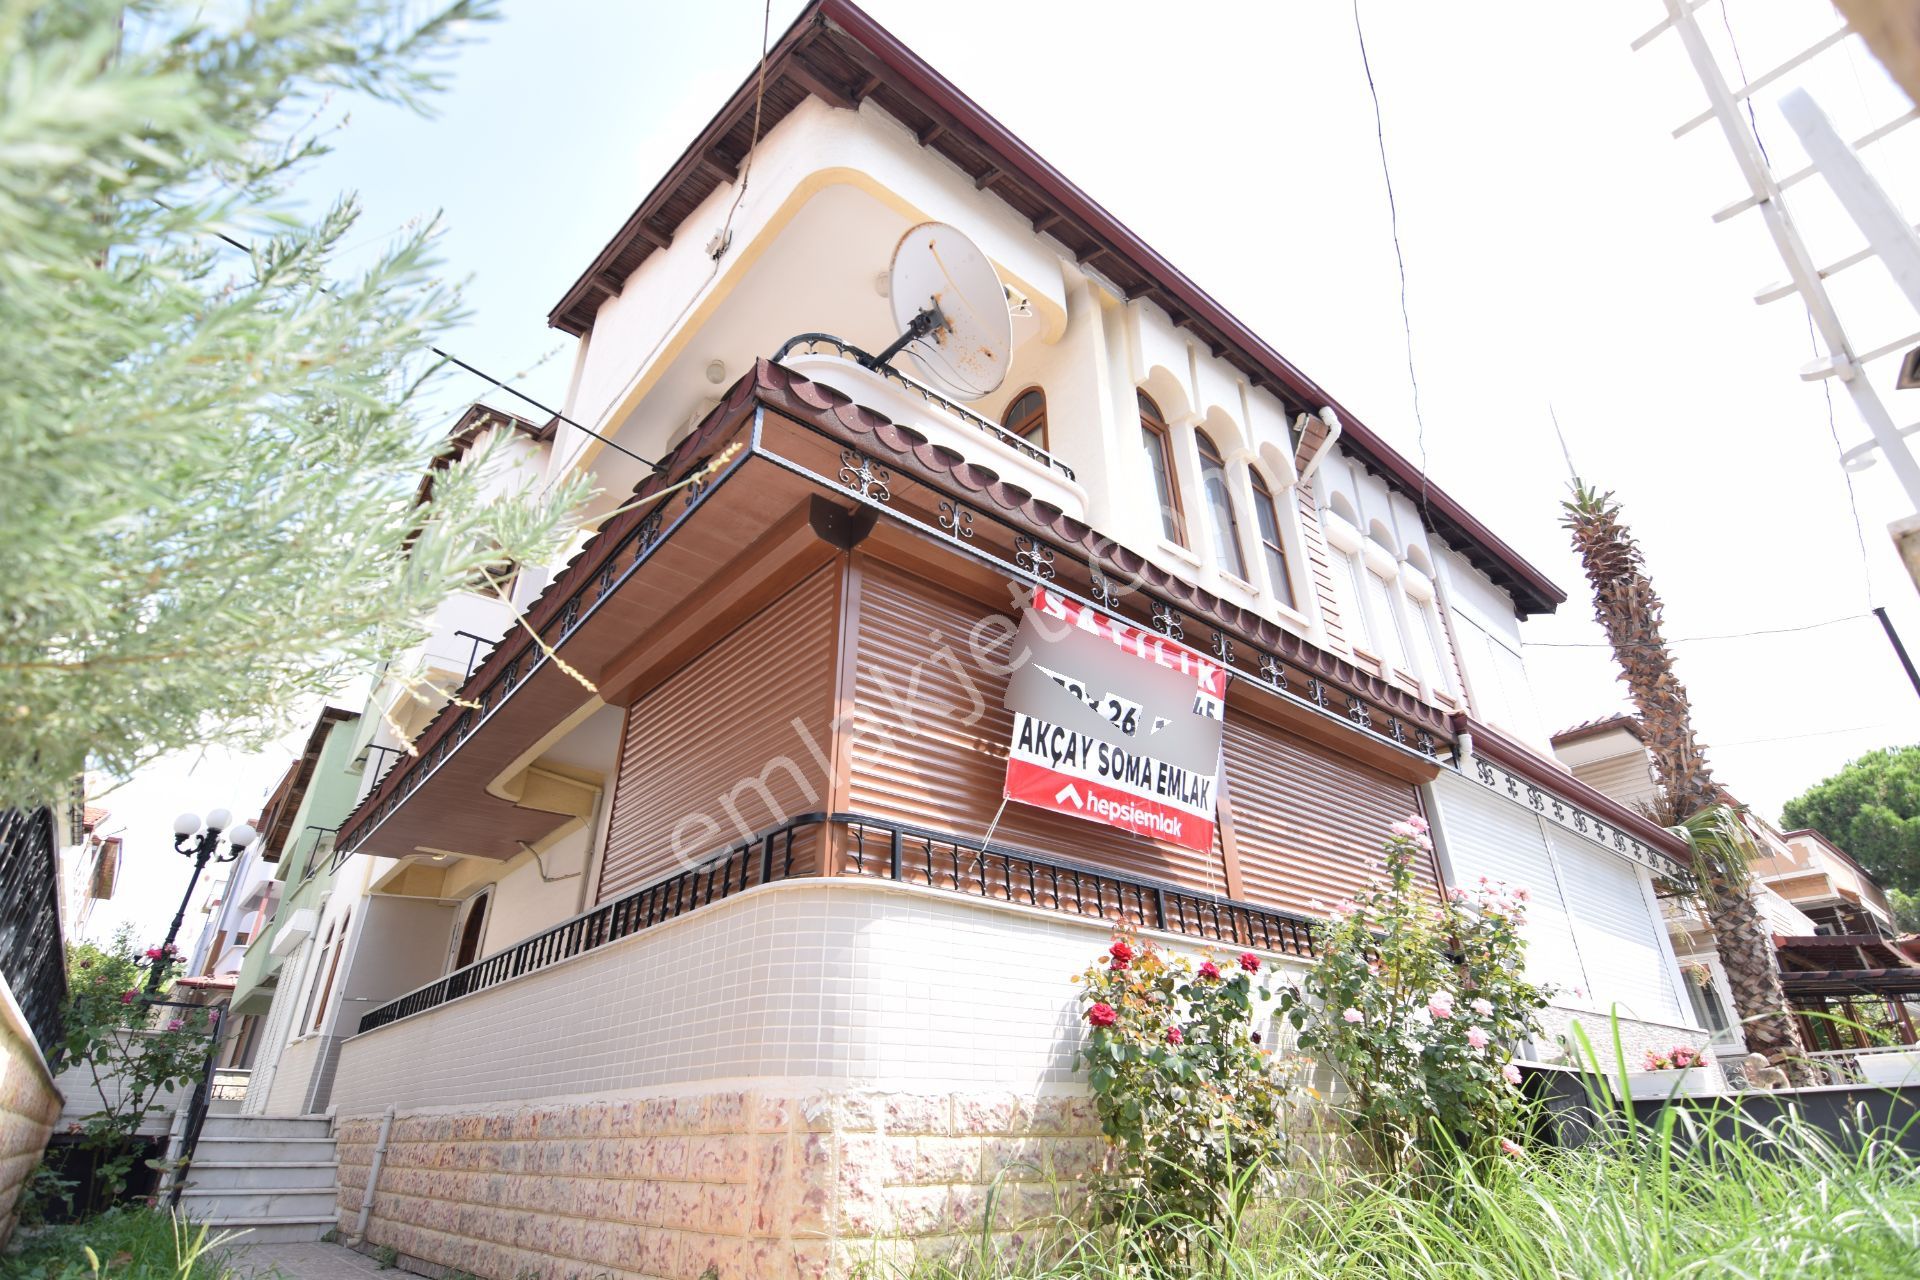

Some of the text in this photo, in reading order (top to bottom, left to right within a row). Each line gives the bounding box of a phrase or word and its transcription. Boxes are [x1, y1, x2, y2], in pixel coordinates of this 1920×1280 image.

[1018, 716, 1210, 811] AKÇAY SOMA EMLAK
[1086, 790, 1182, 837] hepsiemlak
